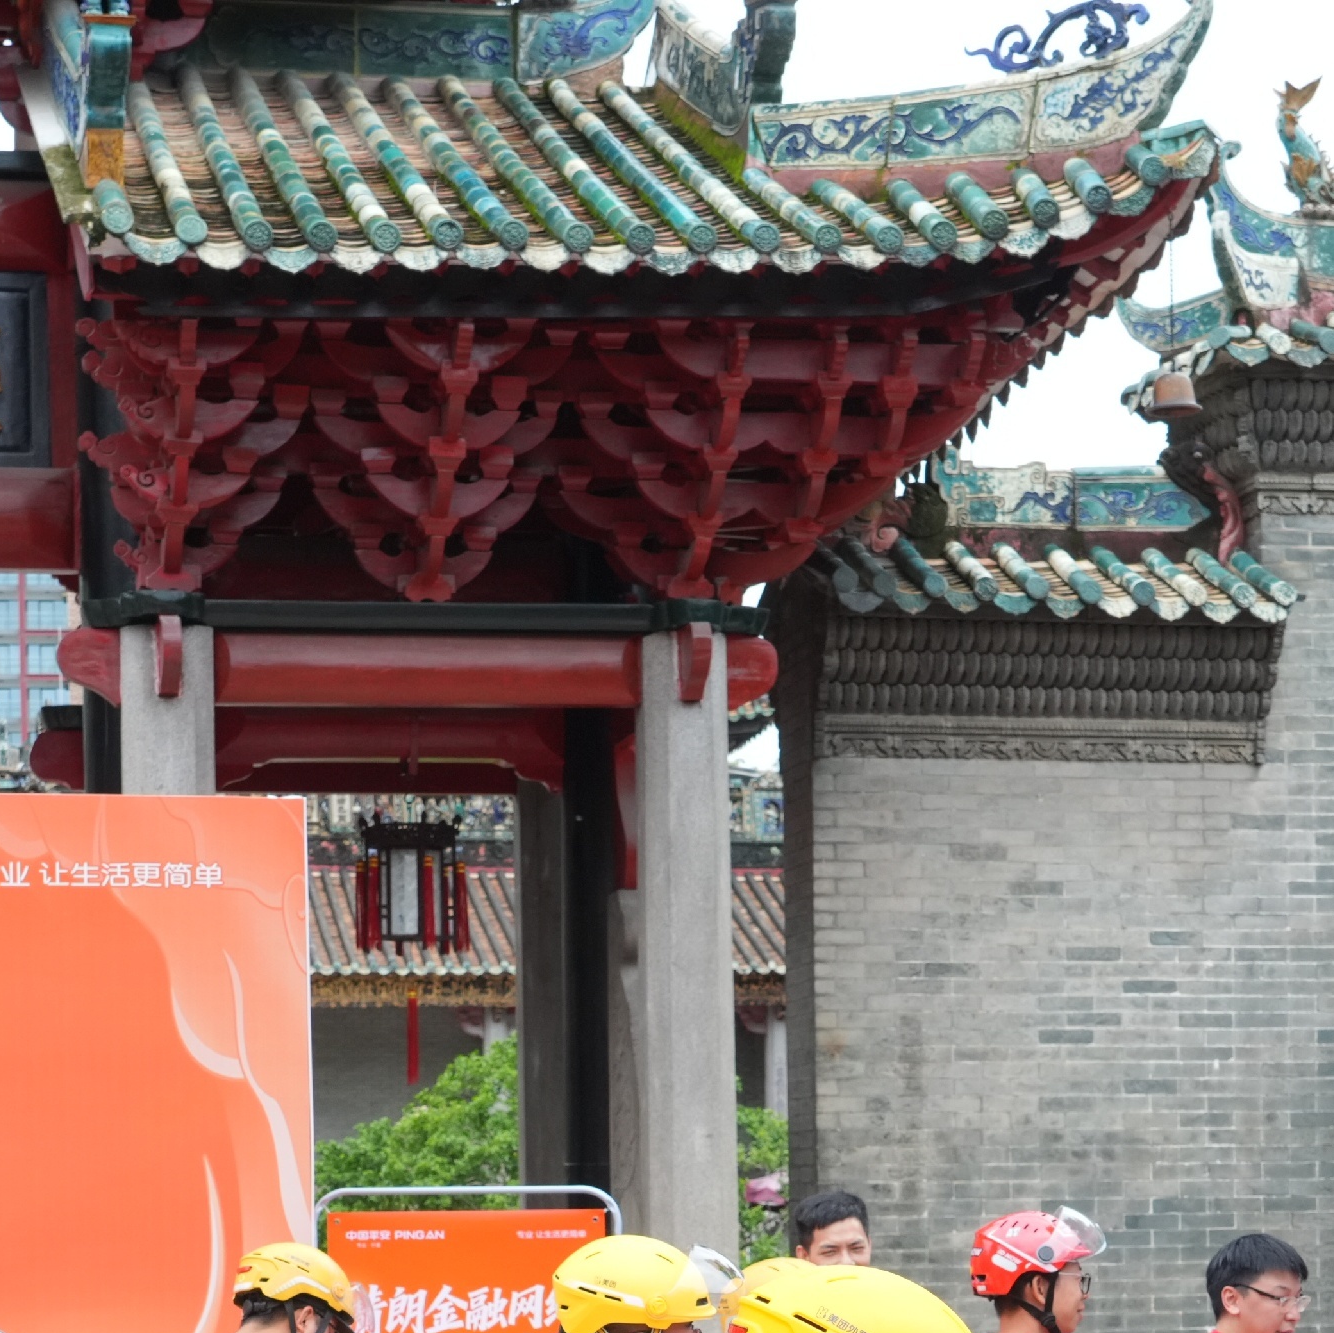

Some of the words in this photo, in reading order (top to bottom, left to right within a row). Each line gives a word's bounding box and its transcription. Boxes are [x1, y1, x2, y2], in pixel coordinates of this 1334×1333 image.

[39, 861, 224, 889] 让生活更简单
[345, 1230, 391, 1240] 中国平安
[394, 1230, 445, 1240] PINGAN
